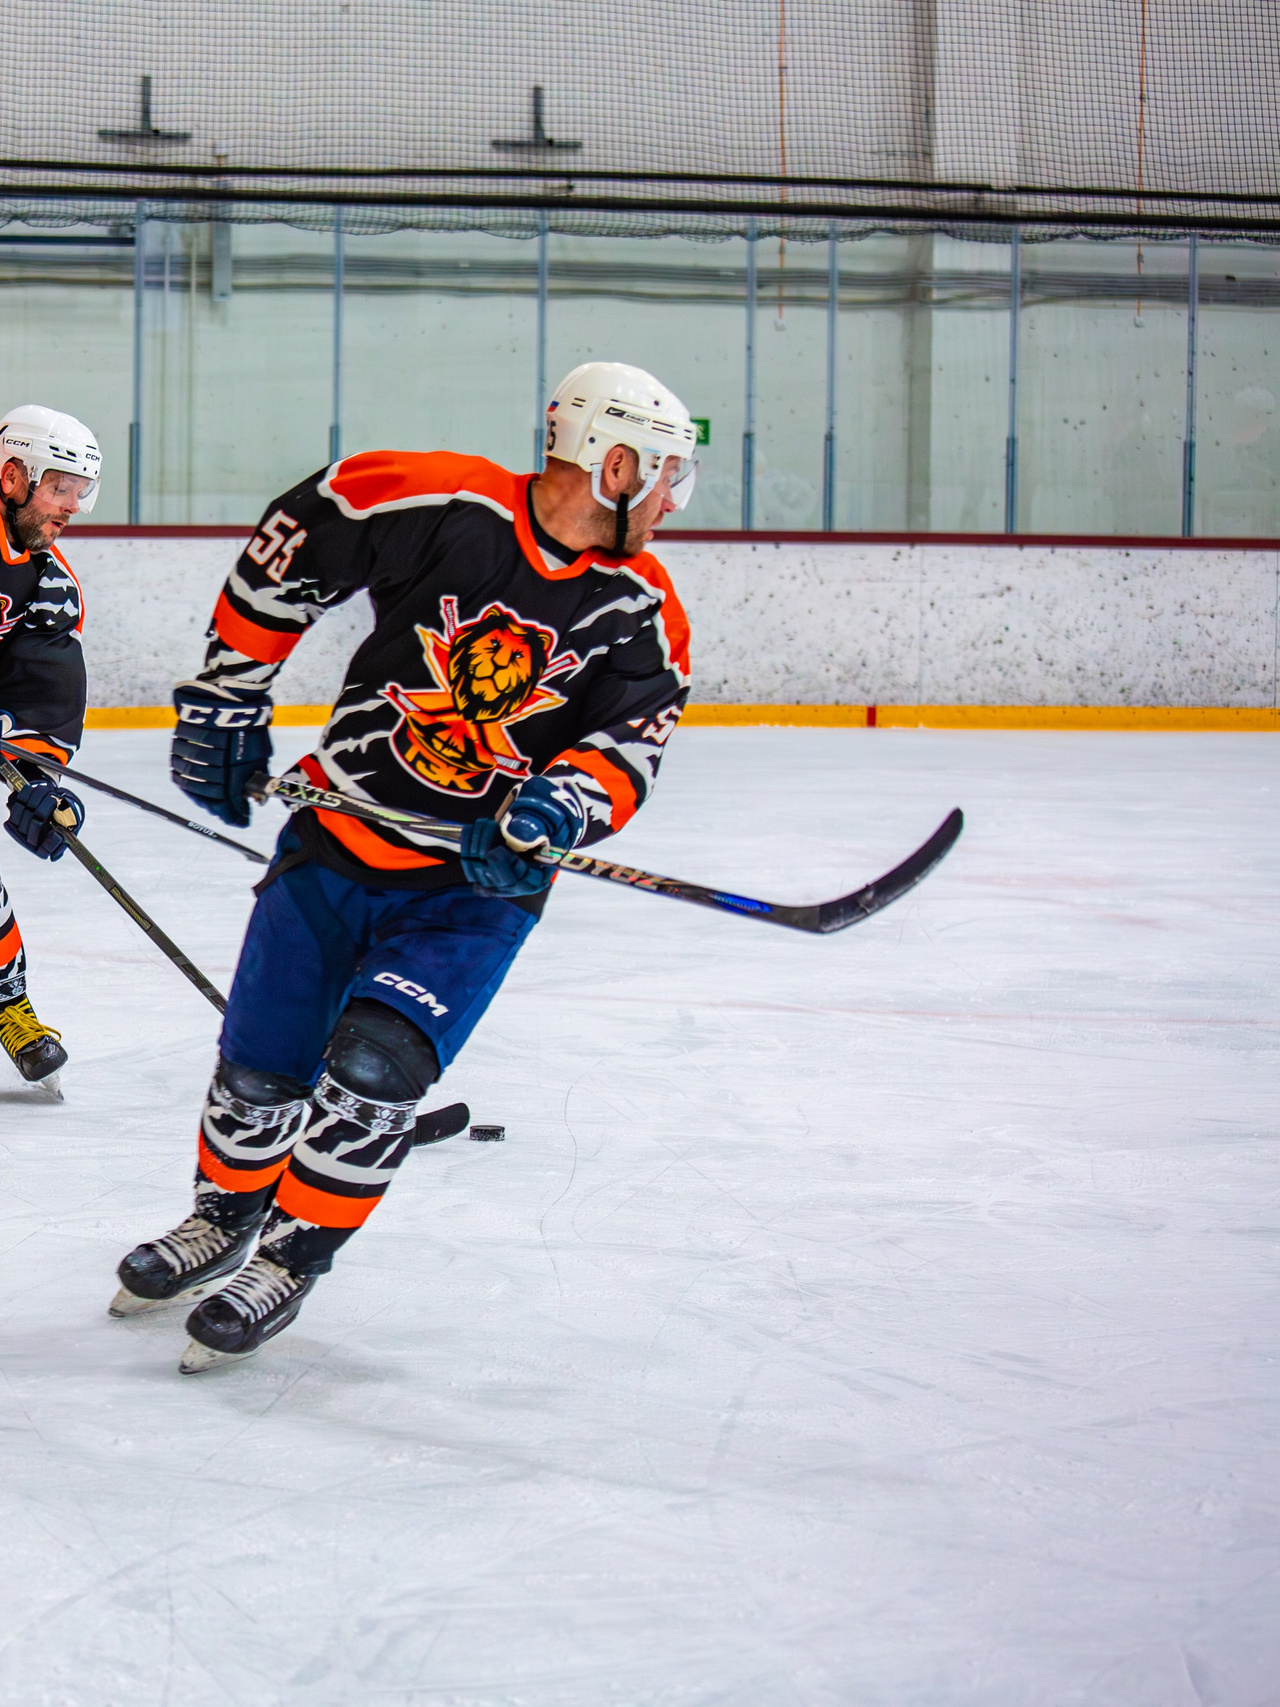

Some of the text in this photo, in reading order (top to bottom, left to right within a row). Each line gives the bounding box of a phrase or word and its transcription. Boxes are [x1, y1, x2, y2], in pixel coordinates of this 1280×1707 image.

[5, 438, 31, 448] CCM
[546, 420, 557, 452] 5
[372, 971, 450, 1018] CCM
